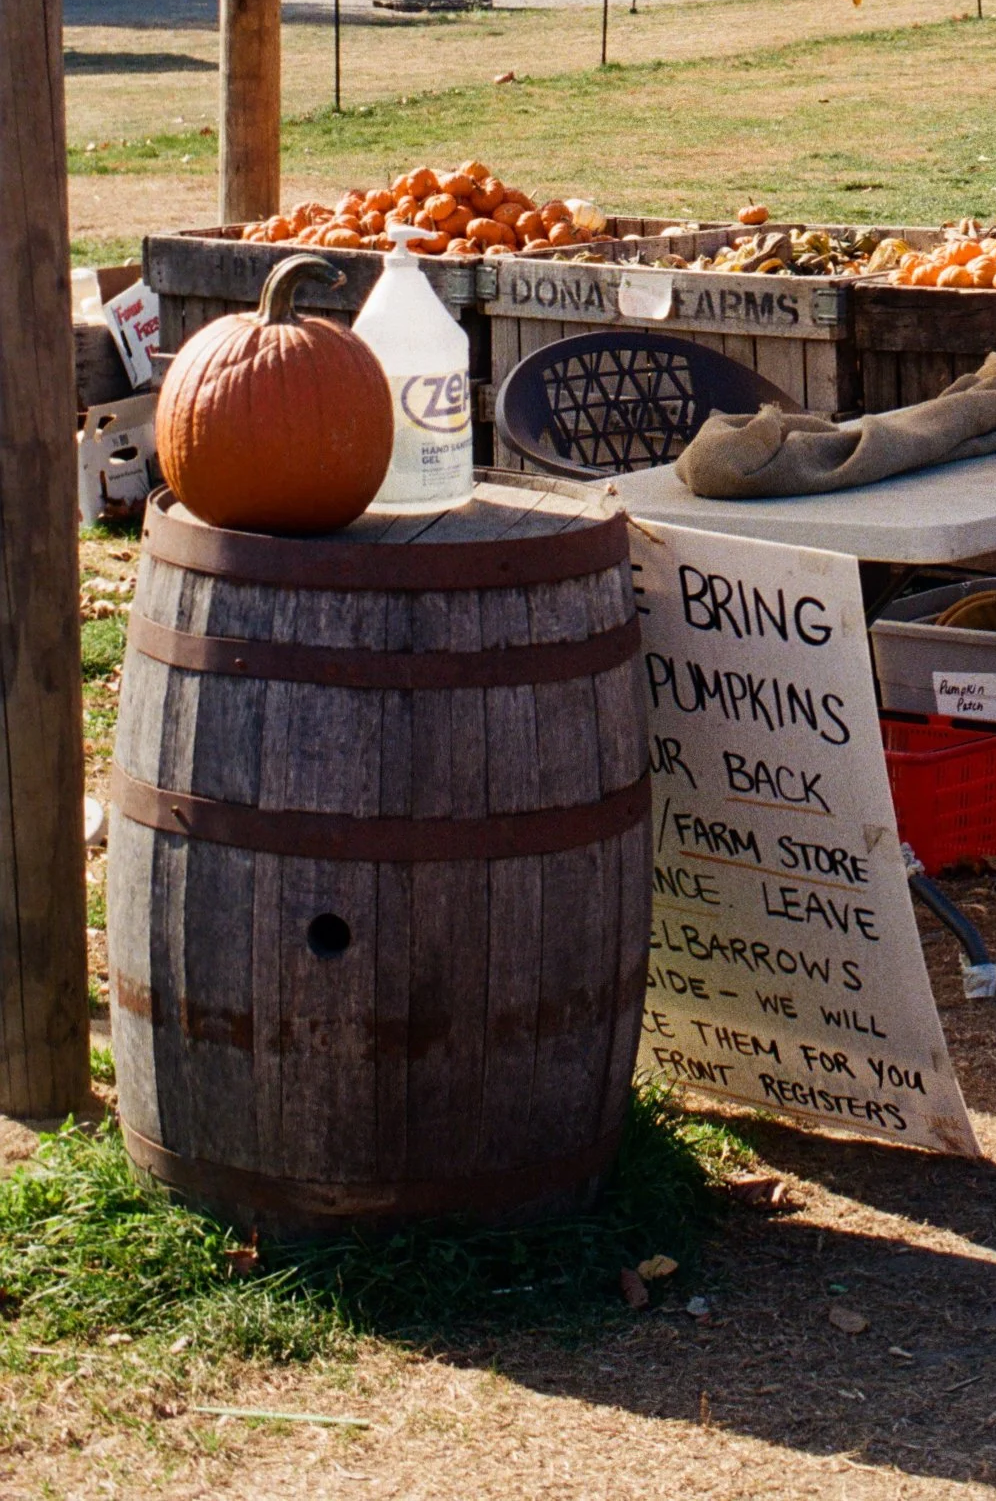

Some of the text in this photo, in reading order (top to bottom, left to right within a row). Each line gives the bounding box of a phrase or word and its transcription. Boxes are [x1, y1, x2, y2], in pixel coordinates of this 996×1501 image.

[511, 277, 800, 325] DONA FARMS
[678, 564, 834, 646] BRING
[645, 651, 851, 746] PUMPKINS
[956, 698, 984, 713] Patch
[722, 750, 832, 814] BACK
[778, 835, 869, 884] STORE
[762, 881, 880, 941] LEAVE
[755, 990, 798, 1019] WE
[820, 1005, 887, 1039] WILL
[690, 1019, 782, 1065] THEM
[799, 1044, 857, 1079] FOR
[867, 1057, 927, 1095] YOU
[651, 1046, 908, 1131] FRONT REGISTERS
